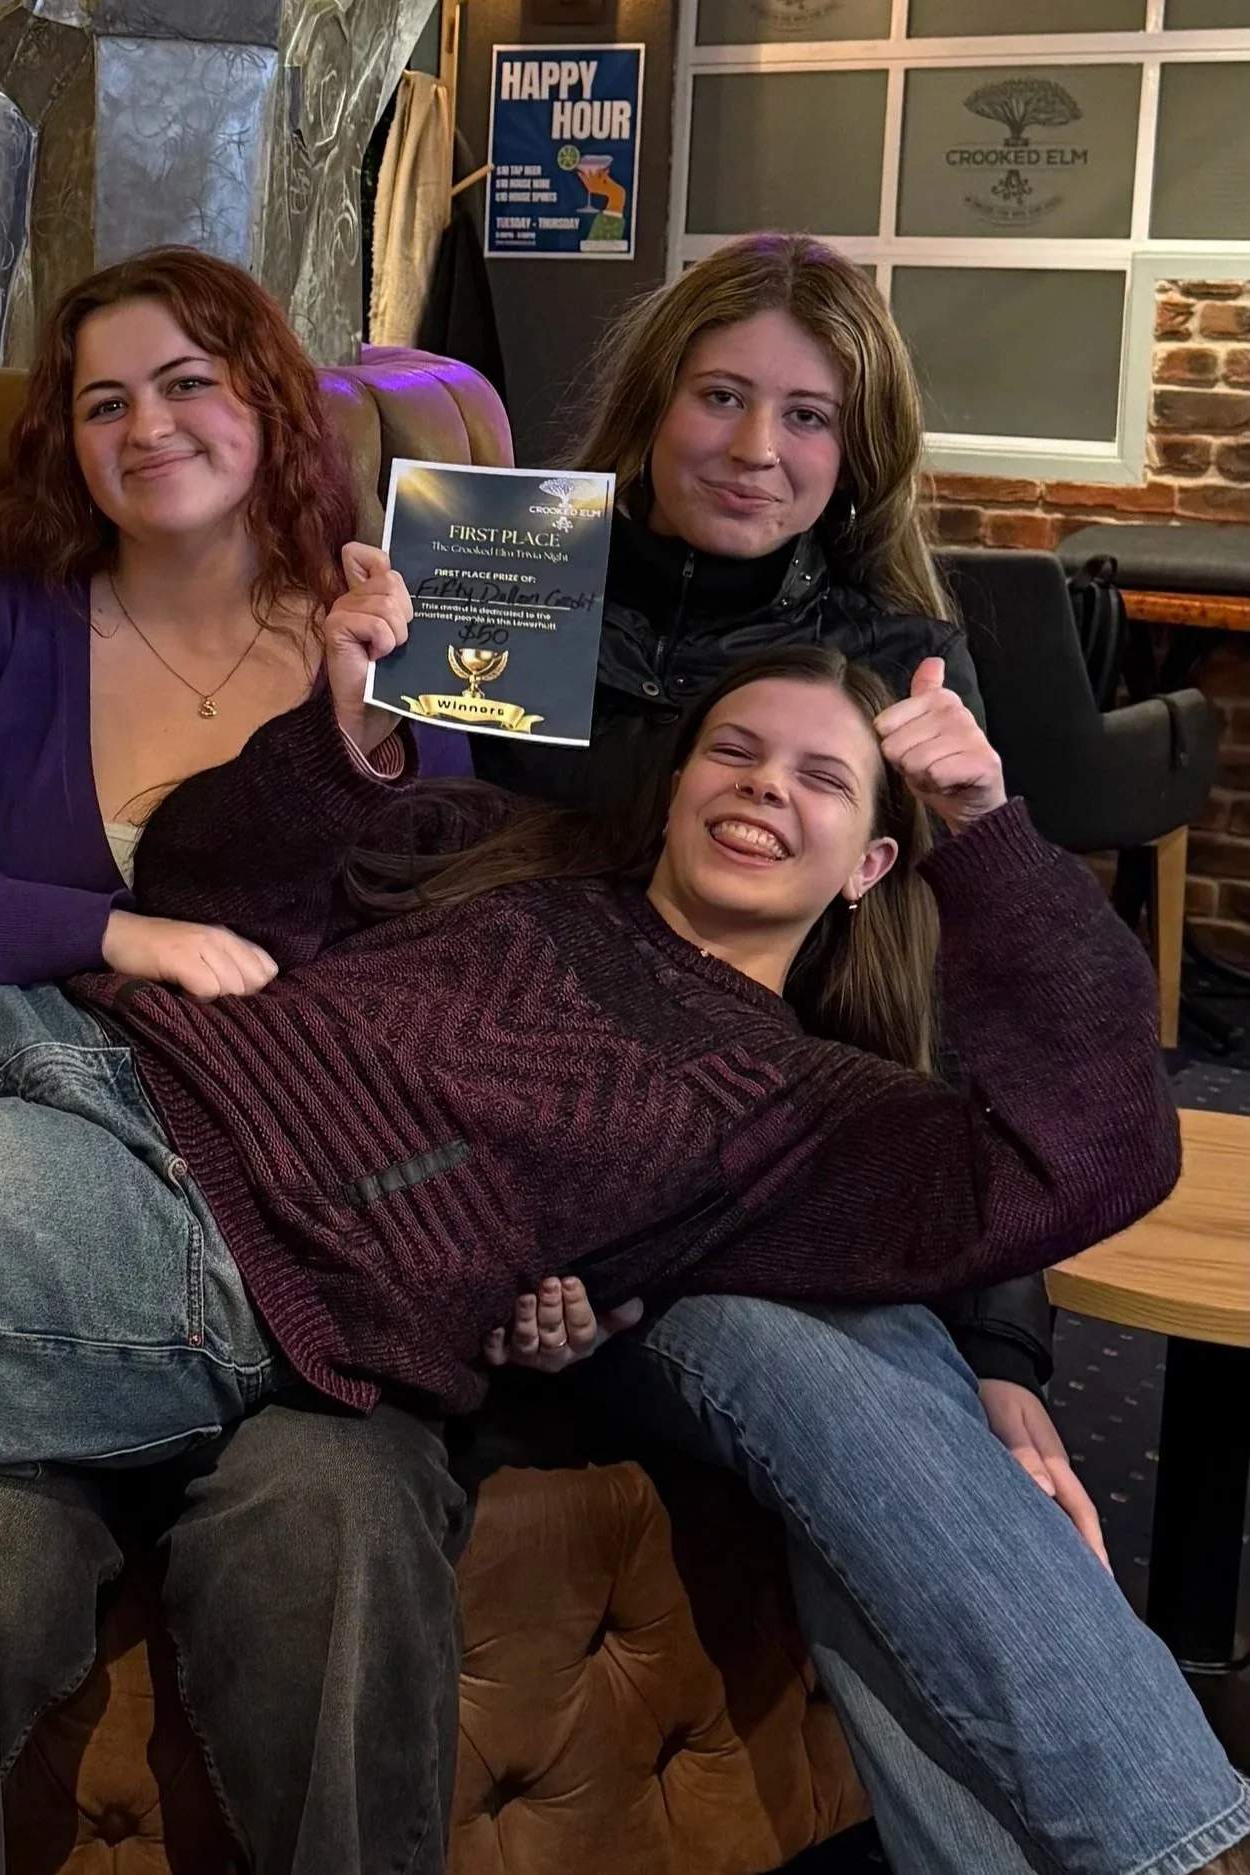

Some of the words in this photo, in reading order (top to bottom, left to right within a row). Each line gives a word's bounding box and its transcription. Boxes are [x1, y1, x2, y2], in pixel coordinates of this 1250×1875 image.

[501, 60, 598, 100] HAPPY
[551, 100, 632, 140] HOUR
[946, 149, 1040, 165] CROOKED
[1046, 149, 1088, 165] ELM
[496, 217, 531, 229] TUESDAY
[538, 217, 580, 230] THURSDAY
[528, 504, 578, 517] CROOKED
[579, 507, 602, 518] ELM
[449, 524, 499, 543] FIRST
[502, 529, 561, 548] PLACE
[432, 541, 450, 552] The
[451, 543, 493, 557] Crooked
[495, 547, 514, 559] Elm
[516, 549, 542, 560] Trivia
[544, 550, 569, 564] Night
[434, 568, 460, 578] FIRST
[461, 570, 492, 580] PLACE
[493, 572, 519, 582] PRIZE
[520, 574, 537, 584] OF:
[414, 611, 453, 621] smartest
[454, 614, 485, 624] people
[486, 615, 495, 624] in
[496, 617, 511, 626] the
[421, 602, 438, 612] This
[469, 606, 477, 614] is
[479, 606, 524, 618] dedicated
[526, 610, 536, 619] to
[537, 611, 552, 620] the
[458, 623, 510, 646] $50
[437, 699, 505, 717] Winners
